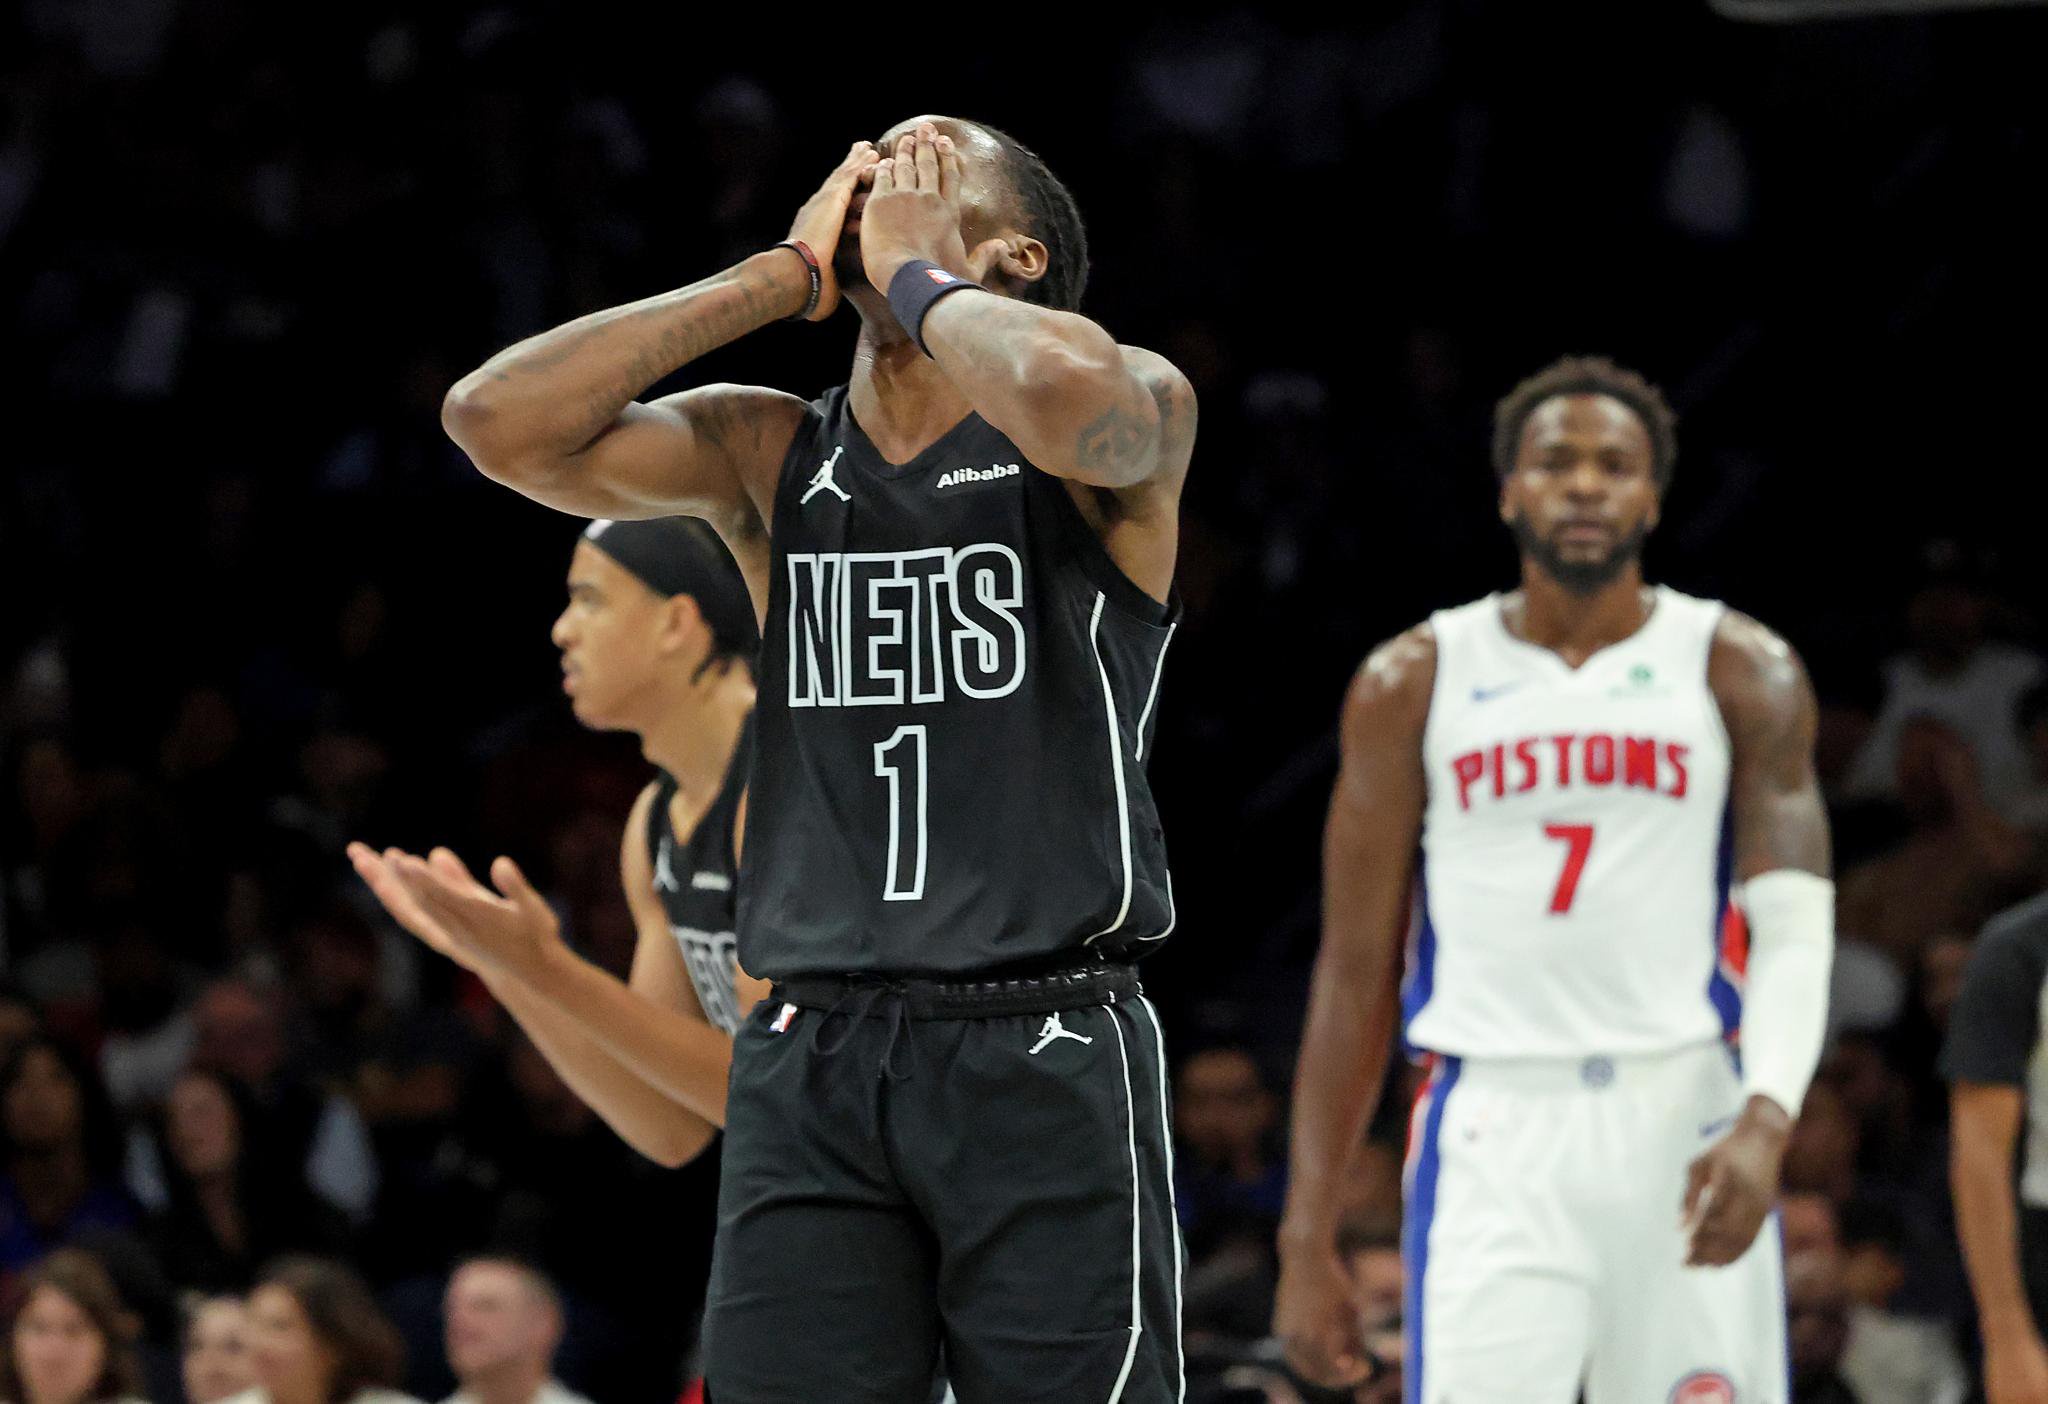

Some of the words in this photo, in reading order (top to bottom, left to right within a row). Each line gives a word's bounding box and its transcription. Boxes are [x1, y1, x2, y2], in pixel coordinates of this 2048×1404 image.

[936, 463, 1020, 489] Alibaba
[786, 542, 1026, 708] NETS
[873, 724, 928, 902] 1
[1451, 733, 1691, 811] PISTONS
[1544, 823, 1595, 914] 7
